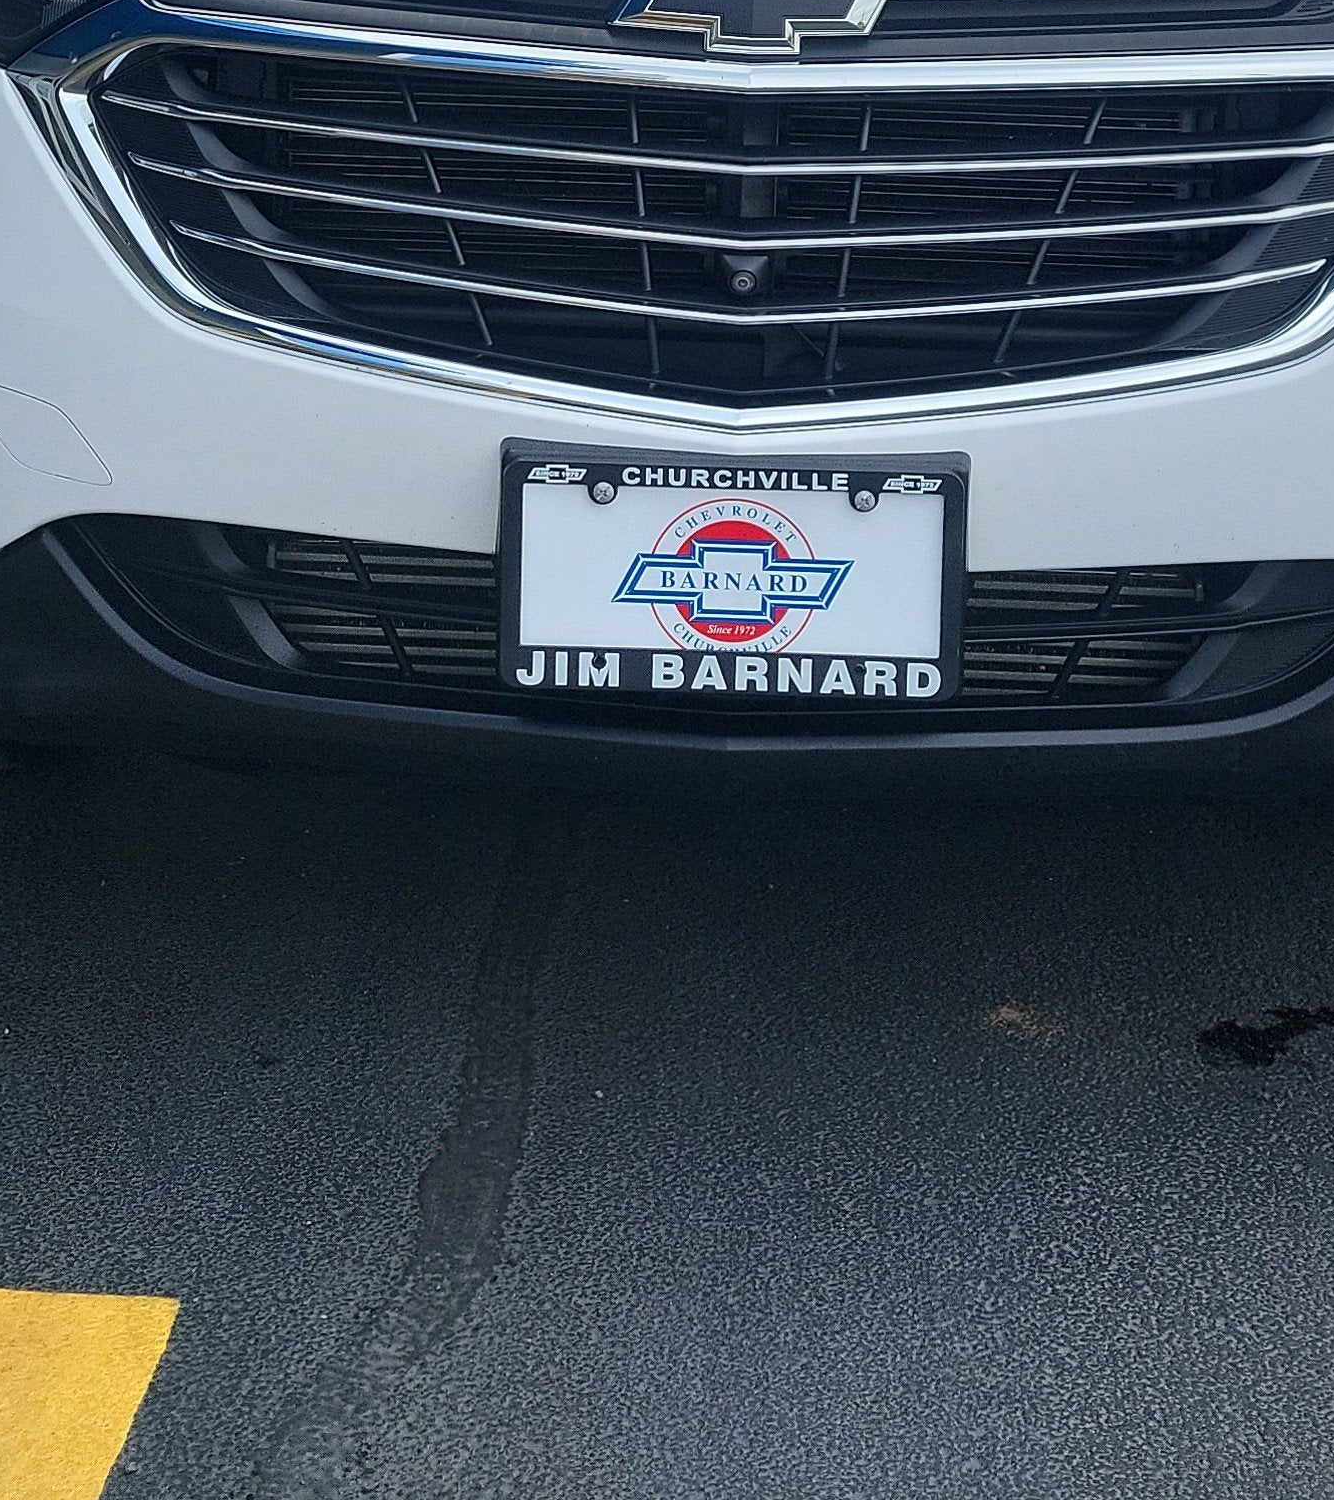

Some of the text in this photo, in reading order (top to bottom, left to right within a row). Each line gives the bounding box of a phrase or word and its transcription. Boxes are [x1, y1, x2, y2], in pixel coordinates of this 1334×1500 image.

[621, 467, 850, 492] CHURCHVILLE
[674, 505, 797, 542] CHEVROLET
[660, 570, 808, 594] BARNARD
[673, 622, 792, 652] CHURILLE
[707, 624, 756, 635] Since 1972
[516, 650, 943, 699] JIM BARNARD
